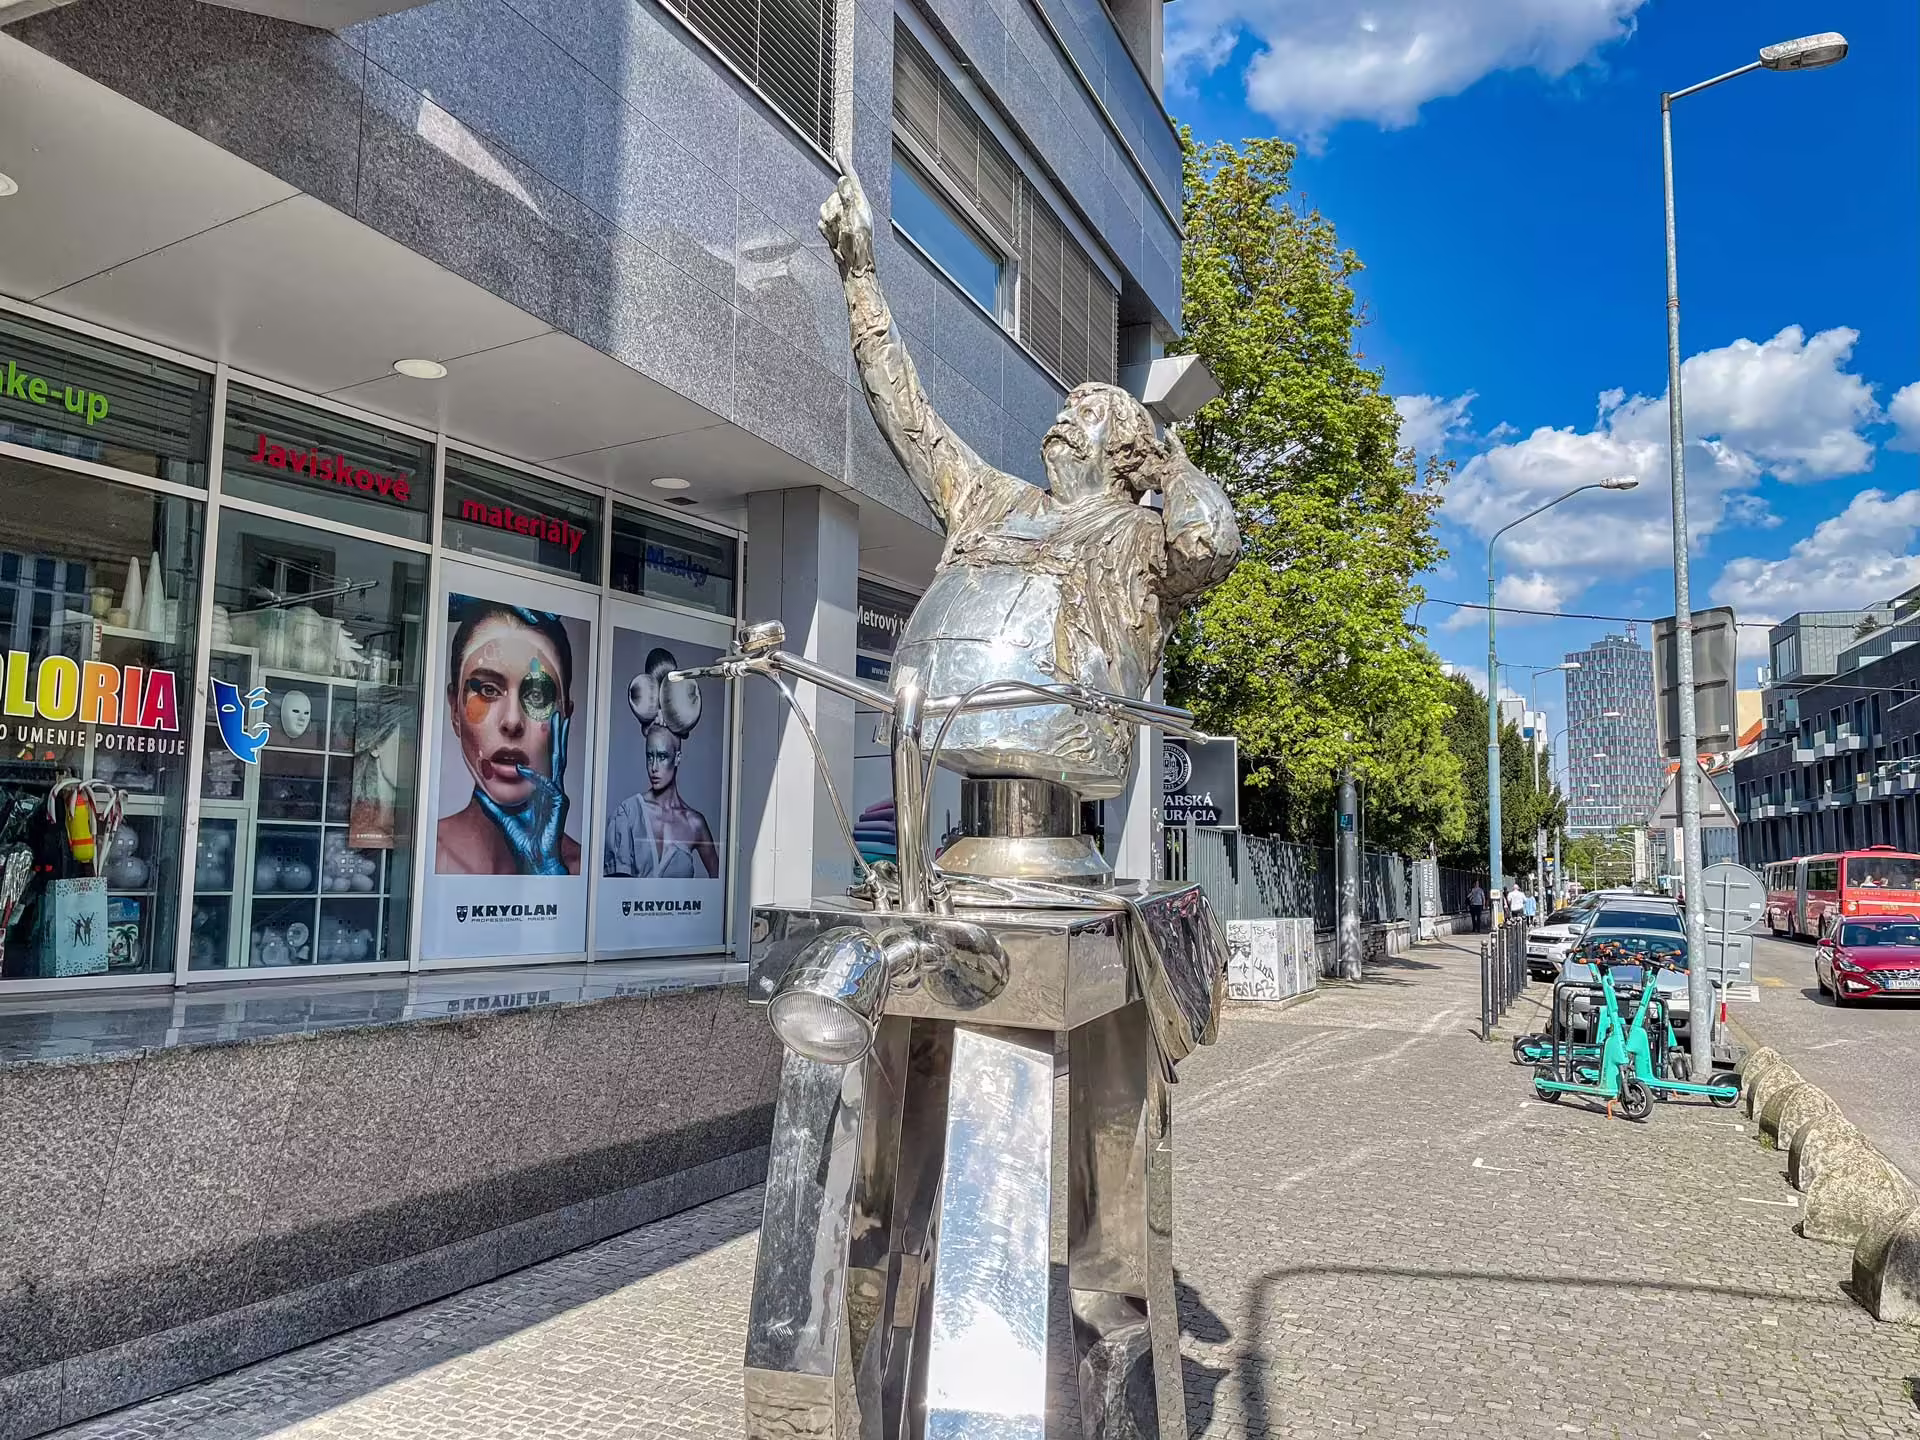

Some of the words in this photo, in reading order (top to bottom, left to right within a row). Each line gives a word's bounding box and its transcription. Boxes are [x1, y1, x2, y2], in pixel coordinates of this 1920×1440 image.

[0, 360, 109, 425] ke-up
[250, 433, 411, 502] Javiskové
[462, 498, 583, 555] materiály
[0, 650, 179, 732] LORIA
[18, 725, 86, 747] UMENIE
[95, 733, 185, 756] POTREBUJE
[1163, 792, 1214, 807] ARSKÁ
[1163, 807, 1217, 821] URÁCIA
[471, 904, 558, 917] KRYOLAN
[633, 900, 702, 912] KRYOLAN
